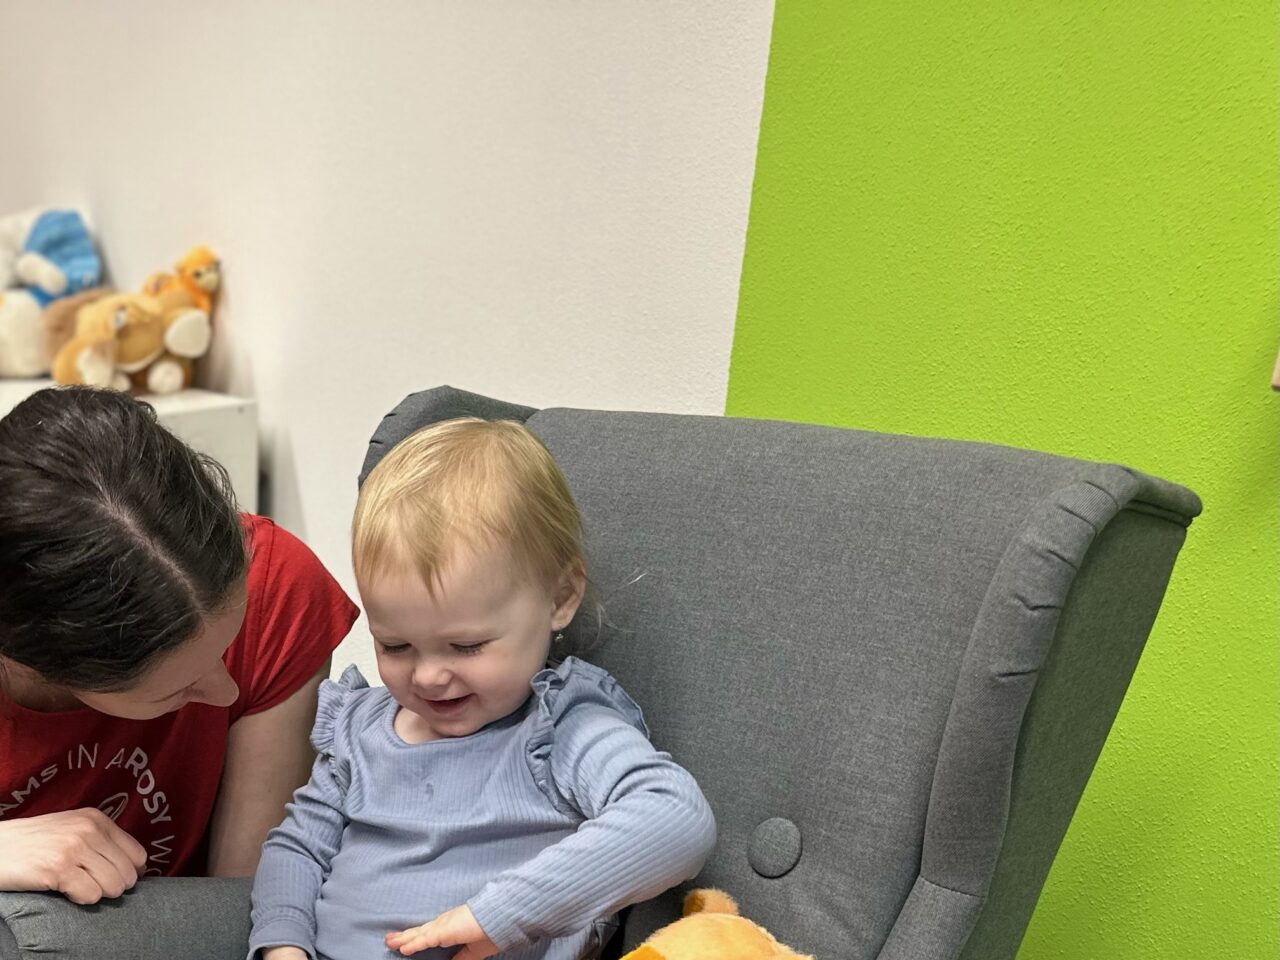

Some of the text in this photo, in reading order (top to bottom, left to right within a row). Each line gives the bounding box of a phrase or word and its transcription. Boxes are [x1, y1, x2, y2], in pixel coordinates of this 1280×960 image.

[68, 743, 99, 770] IN
[105, 748, 125, 770] A
[124, 747, 172, 824] ROSY
